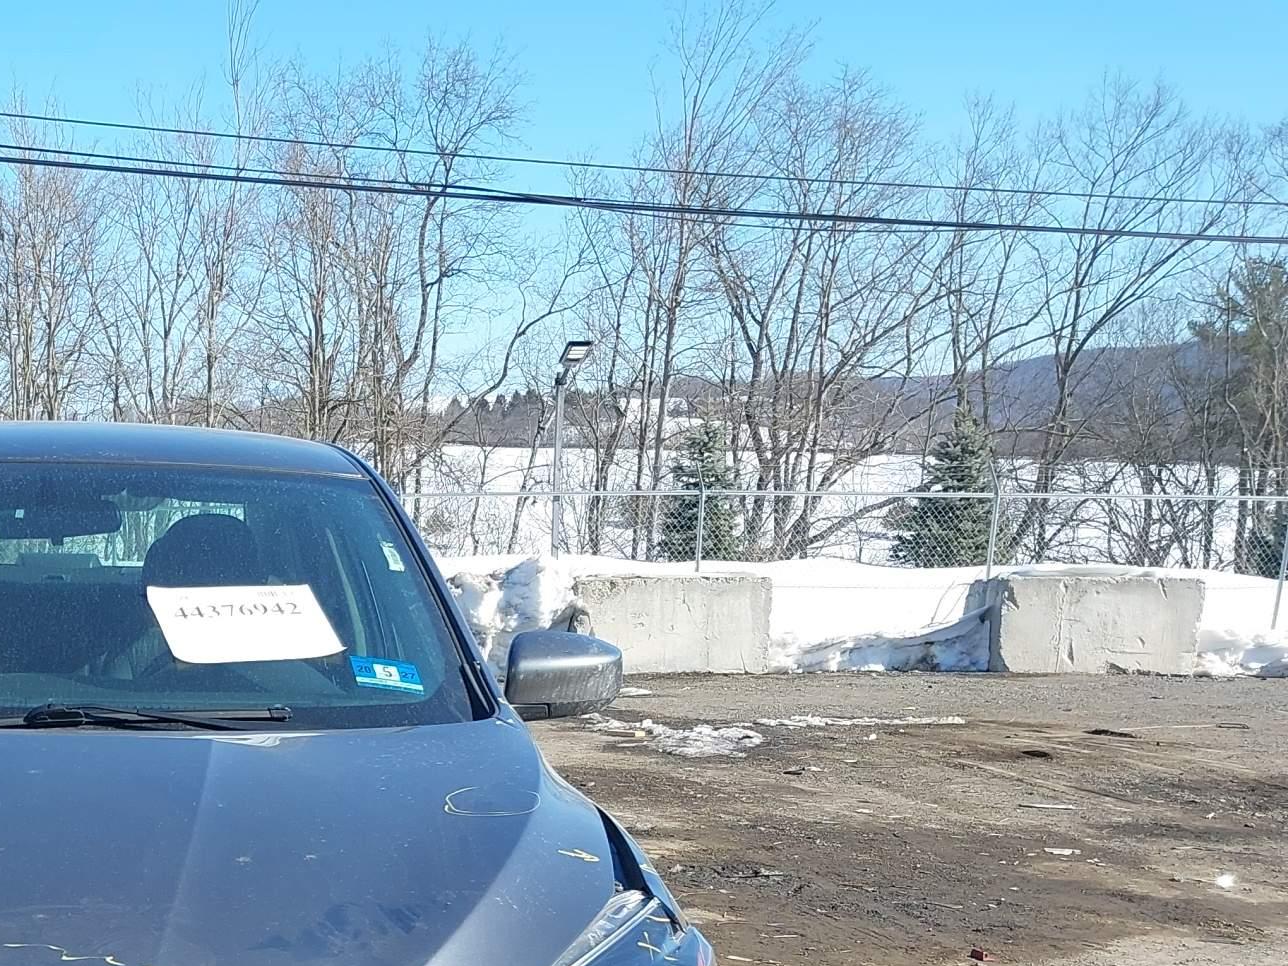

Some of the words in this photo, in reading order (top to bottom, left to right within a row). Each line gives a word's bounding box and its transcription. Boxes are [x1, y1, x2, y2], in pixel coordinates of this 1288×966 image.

[175, 602, 302, 619] 44376942
[356, 664, 372, 674] 20
[382, 666, 393, 678] 5
[400, 671, 416, 680] 27
